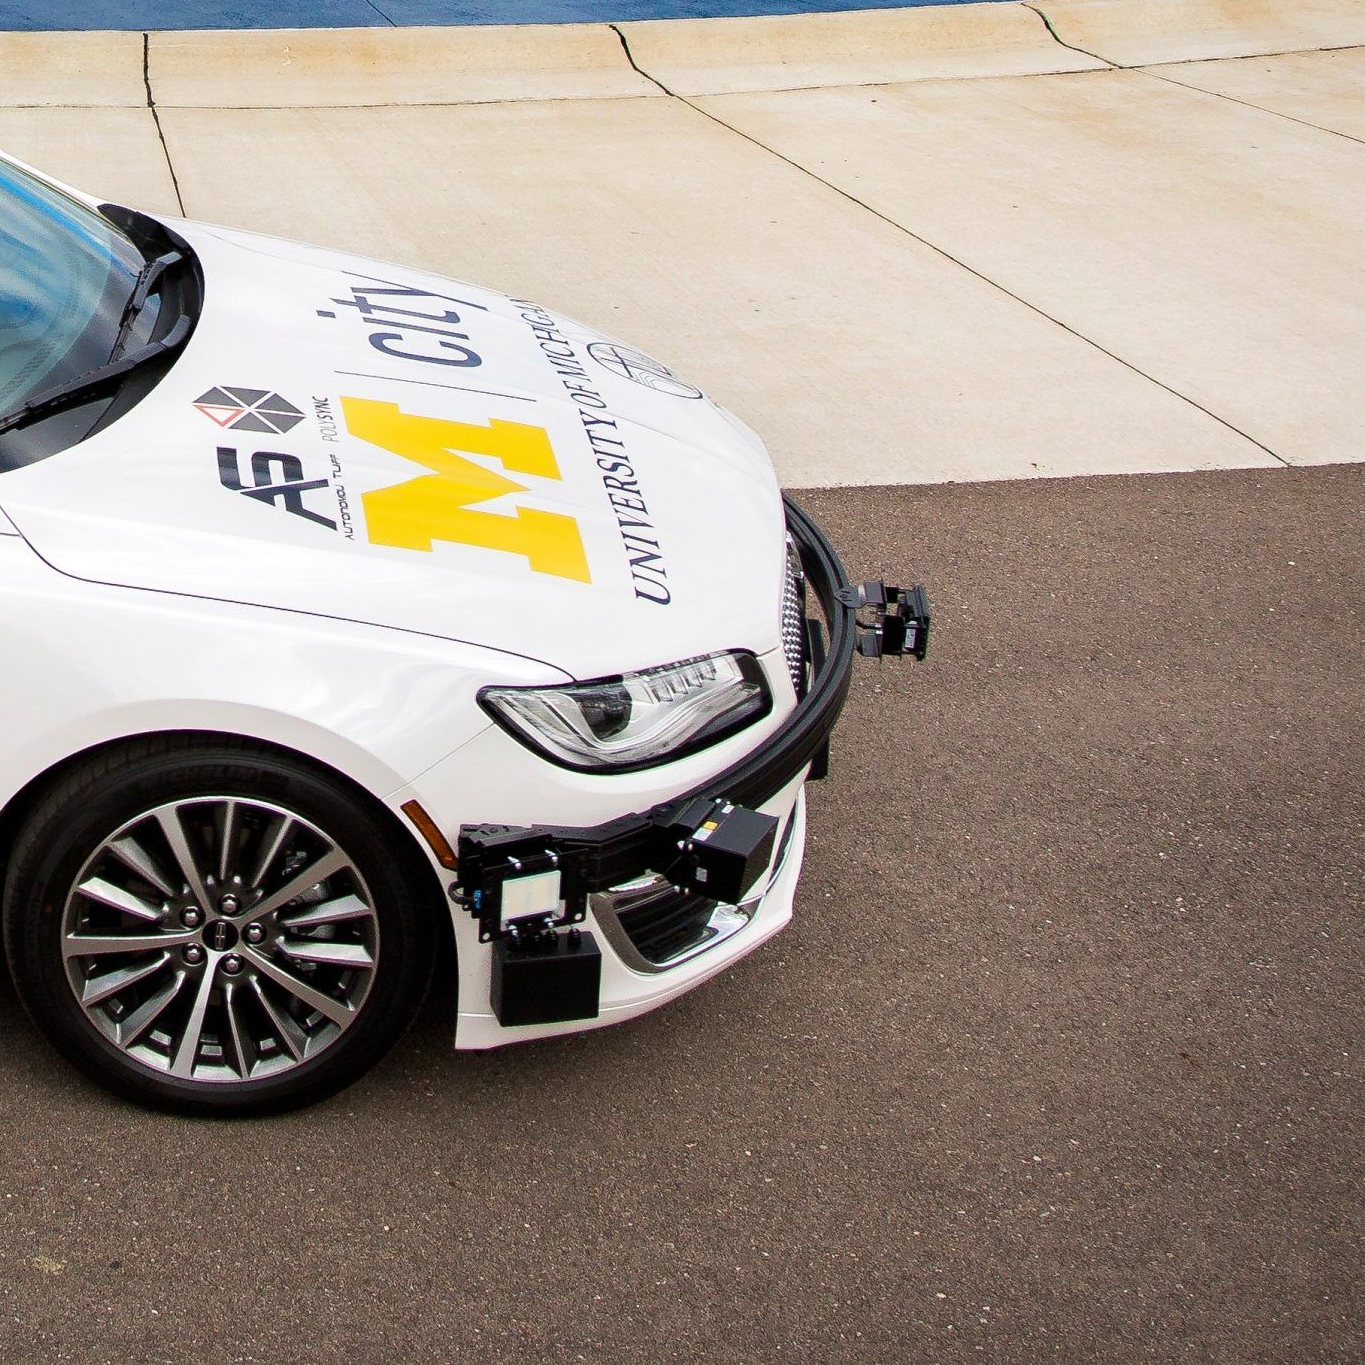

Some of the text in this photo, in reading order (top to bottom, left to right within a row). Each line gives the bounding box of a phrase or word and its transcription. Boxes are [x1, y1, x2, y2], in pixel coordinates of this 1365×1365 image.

[316, 271, 490, 368] city
[312, 396, 338, 442] POLYSYNC
[562, 379, 607, 410] OF
[340, 396, 592, 584] M
[578, 408, 672, 606] UNIVERSITY
